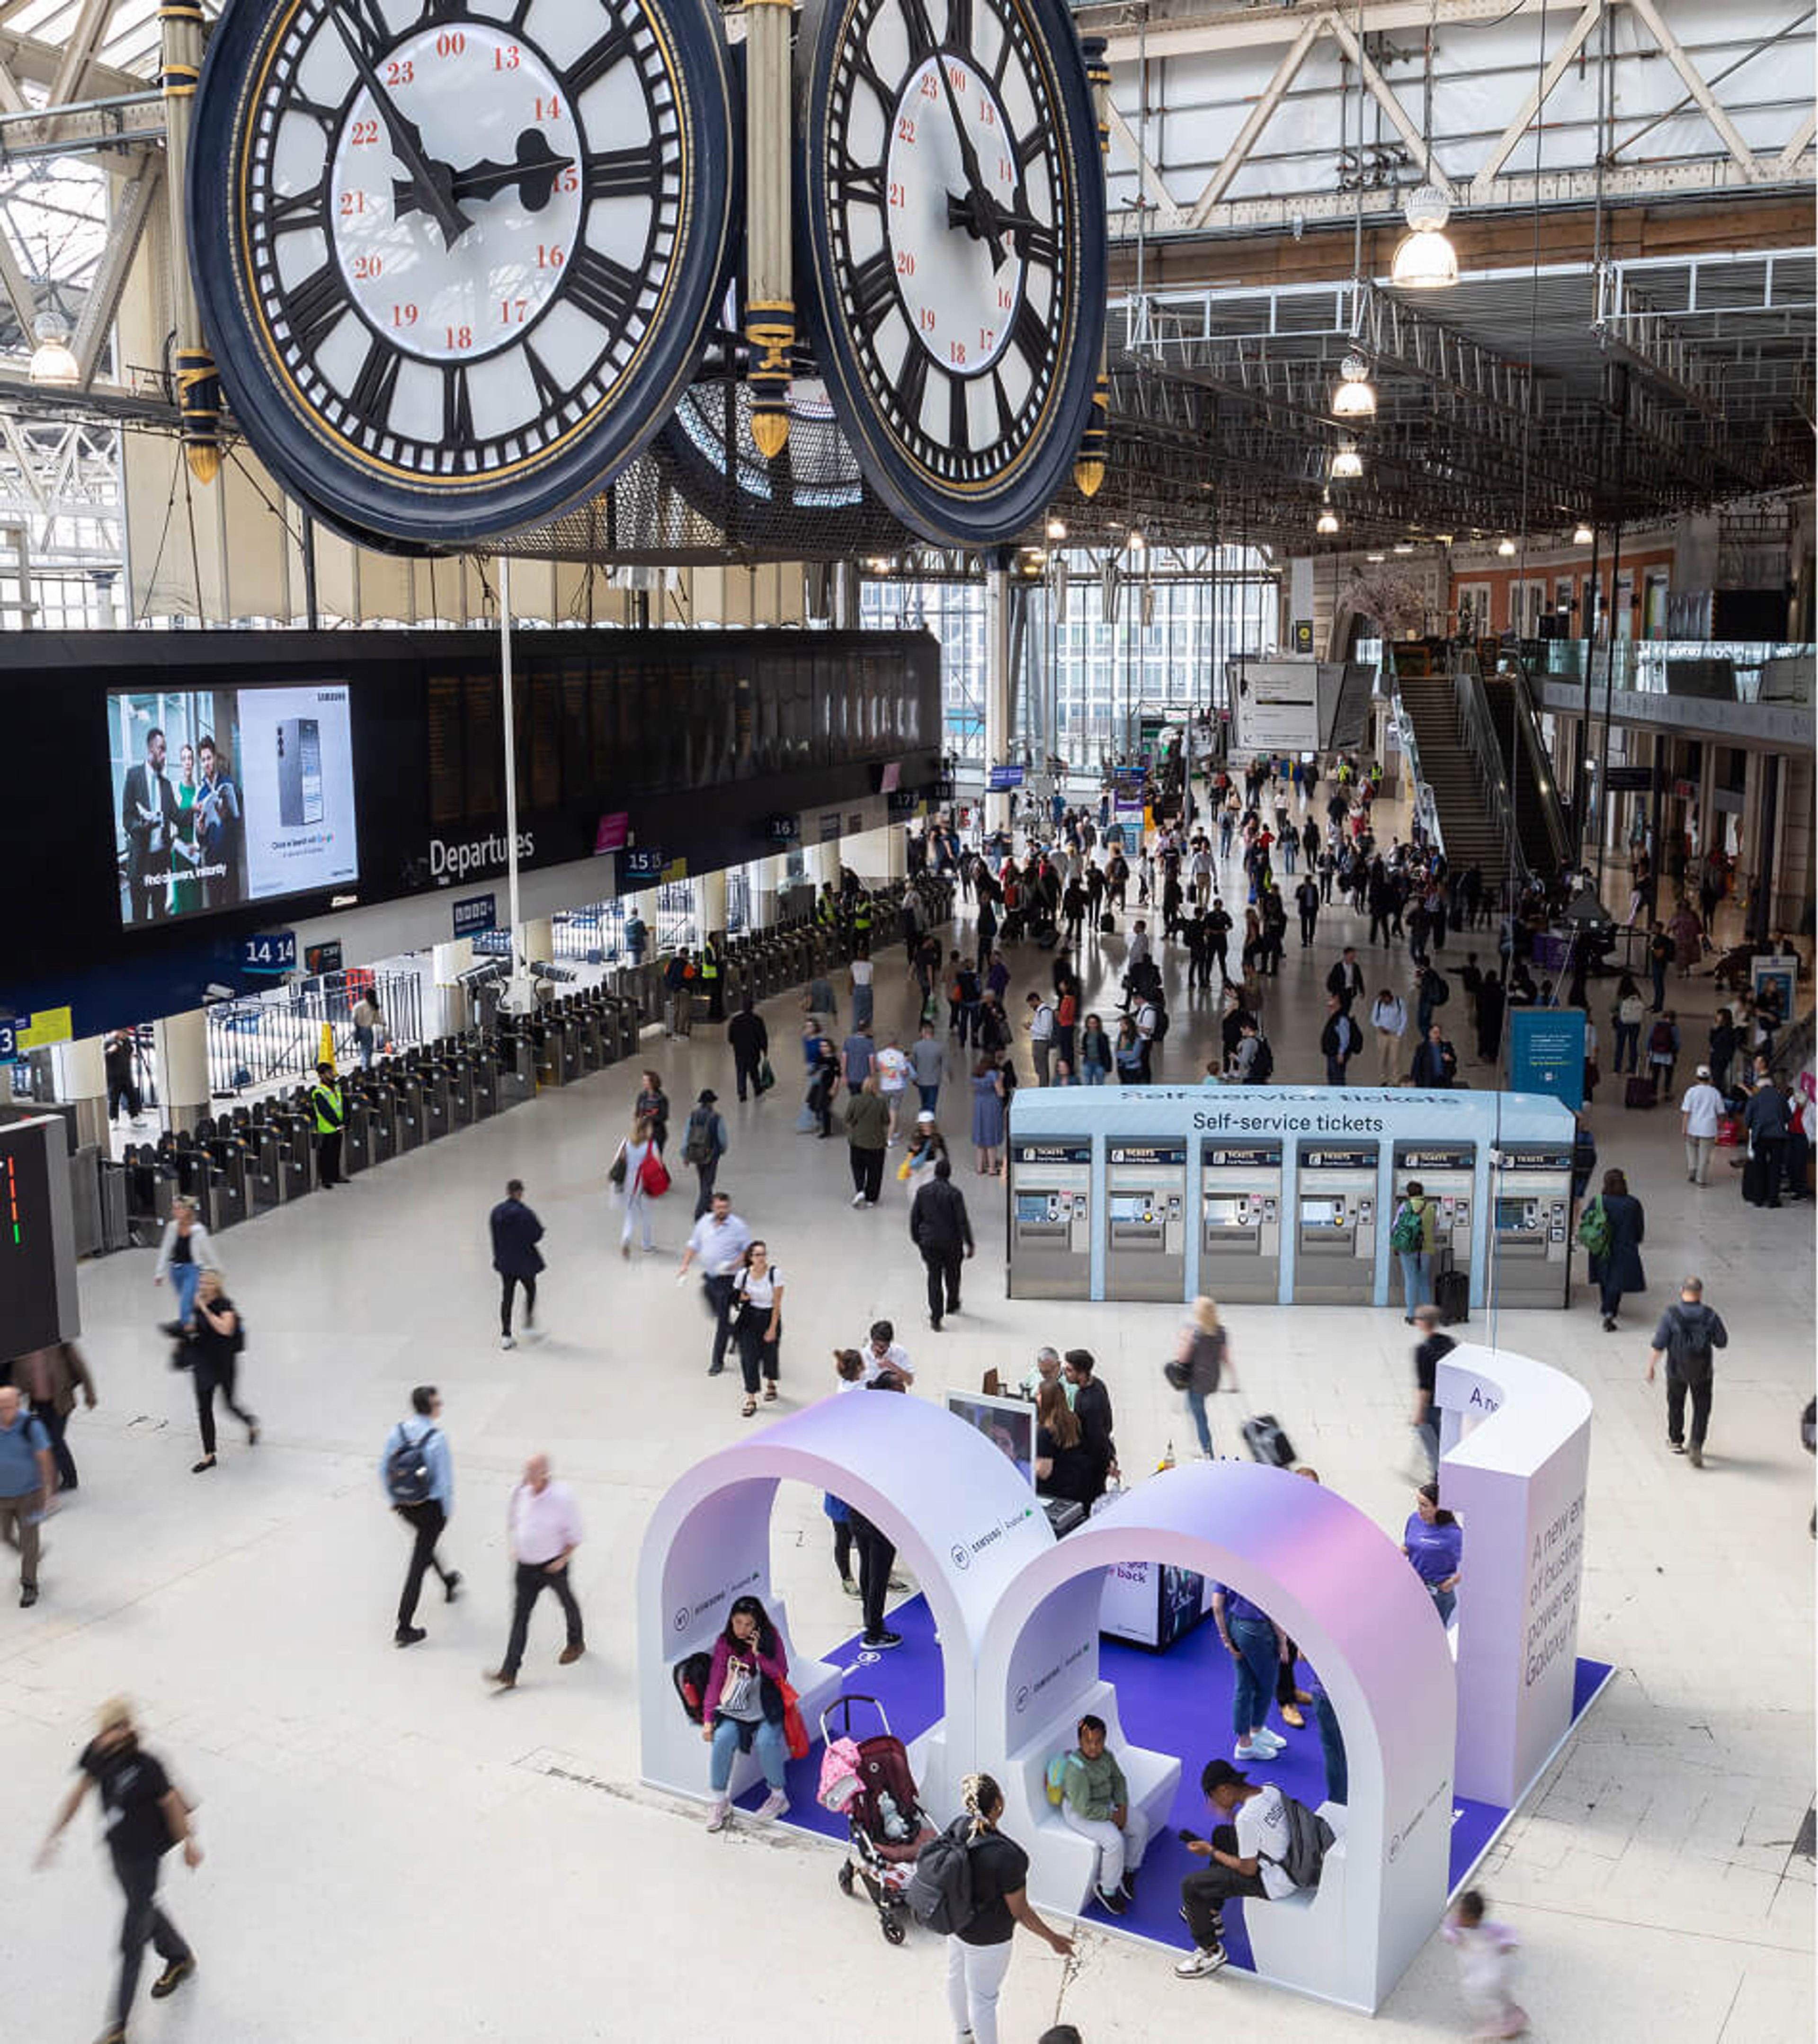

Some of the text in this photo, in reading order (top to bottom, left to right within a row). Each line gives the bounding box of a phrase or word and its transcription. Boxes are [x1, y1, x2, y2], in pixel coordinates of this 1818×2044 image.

[436, 32, 465, 57] 00
[494, 45, 520, 71] 13
[387, 61, 414, 86] 23
[949, 68, 966, 92] 00
[920, 73, 937, 100] 23
[535, 95, 561, 122] 14
[980, 100, 994, 125] 13
[351, 120, 379, 145] 22
[898, 117, 916, 143] 22
[553, 168, 579, 194] 15
[340, 191, 365, 215] 21
[889, 183, 905, 209] 21
[354, 257, 382, 279] 20
[536, 244, 564, 269] 16
[897, 251, 915, 276] 20
[998, 286, 1012, 310] 16
[393, 304, 419, 327] 19
[500, 300, 526, 323] 17
[920, 307, 936, 331] 19
[446, 325, 472, 349] 18
[980, 329, 994, 352] 17
[951, 341, 965, 364] 18
[430, 832, 535, 878] Departues
[629, 853, 649, 870] 15
[245, 941, 272, 963] 14
[277, 938, 294, 963] 14
[1193, 1112, 1384, 1132] Self-service tickets
[1469, 1386, 1482, 1407] A
[1532, 1533, 1542, 1570] A
[1544, 1509, 1568, 1555] new
[1117, 1566, 1147, 1584] back
